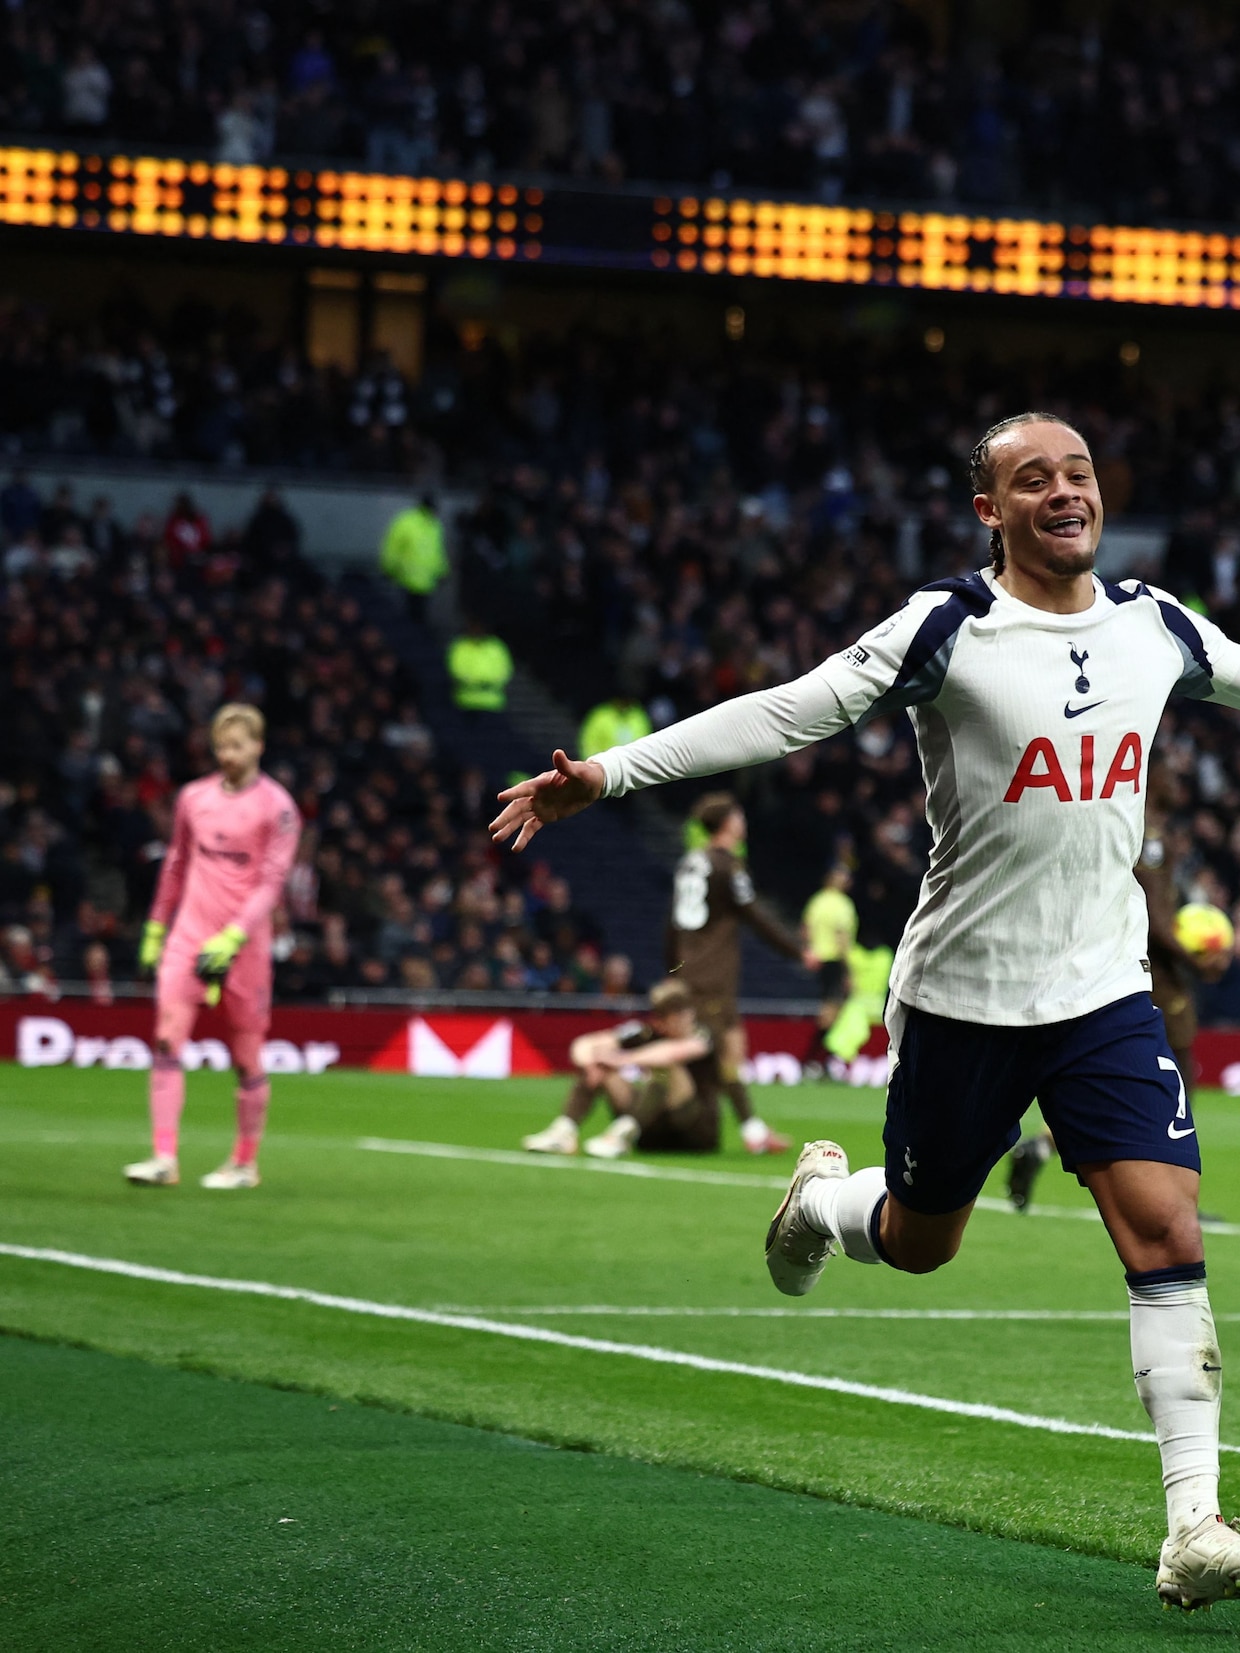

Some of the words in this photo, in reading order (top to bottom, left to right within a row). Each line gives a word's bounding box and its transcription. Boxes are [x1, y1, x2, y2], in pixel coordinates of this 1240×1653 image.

[1002, 732, 1142, 804] AIA
[1156, 1055, 1187, 1120] 7
[822, 1150, 843, 1159] XAVI
